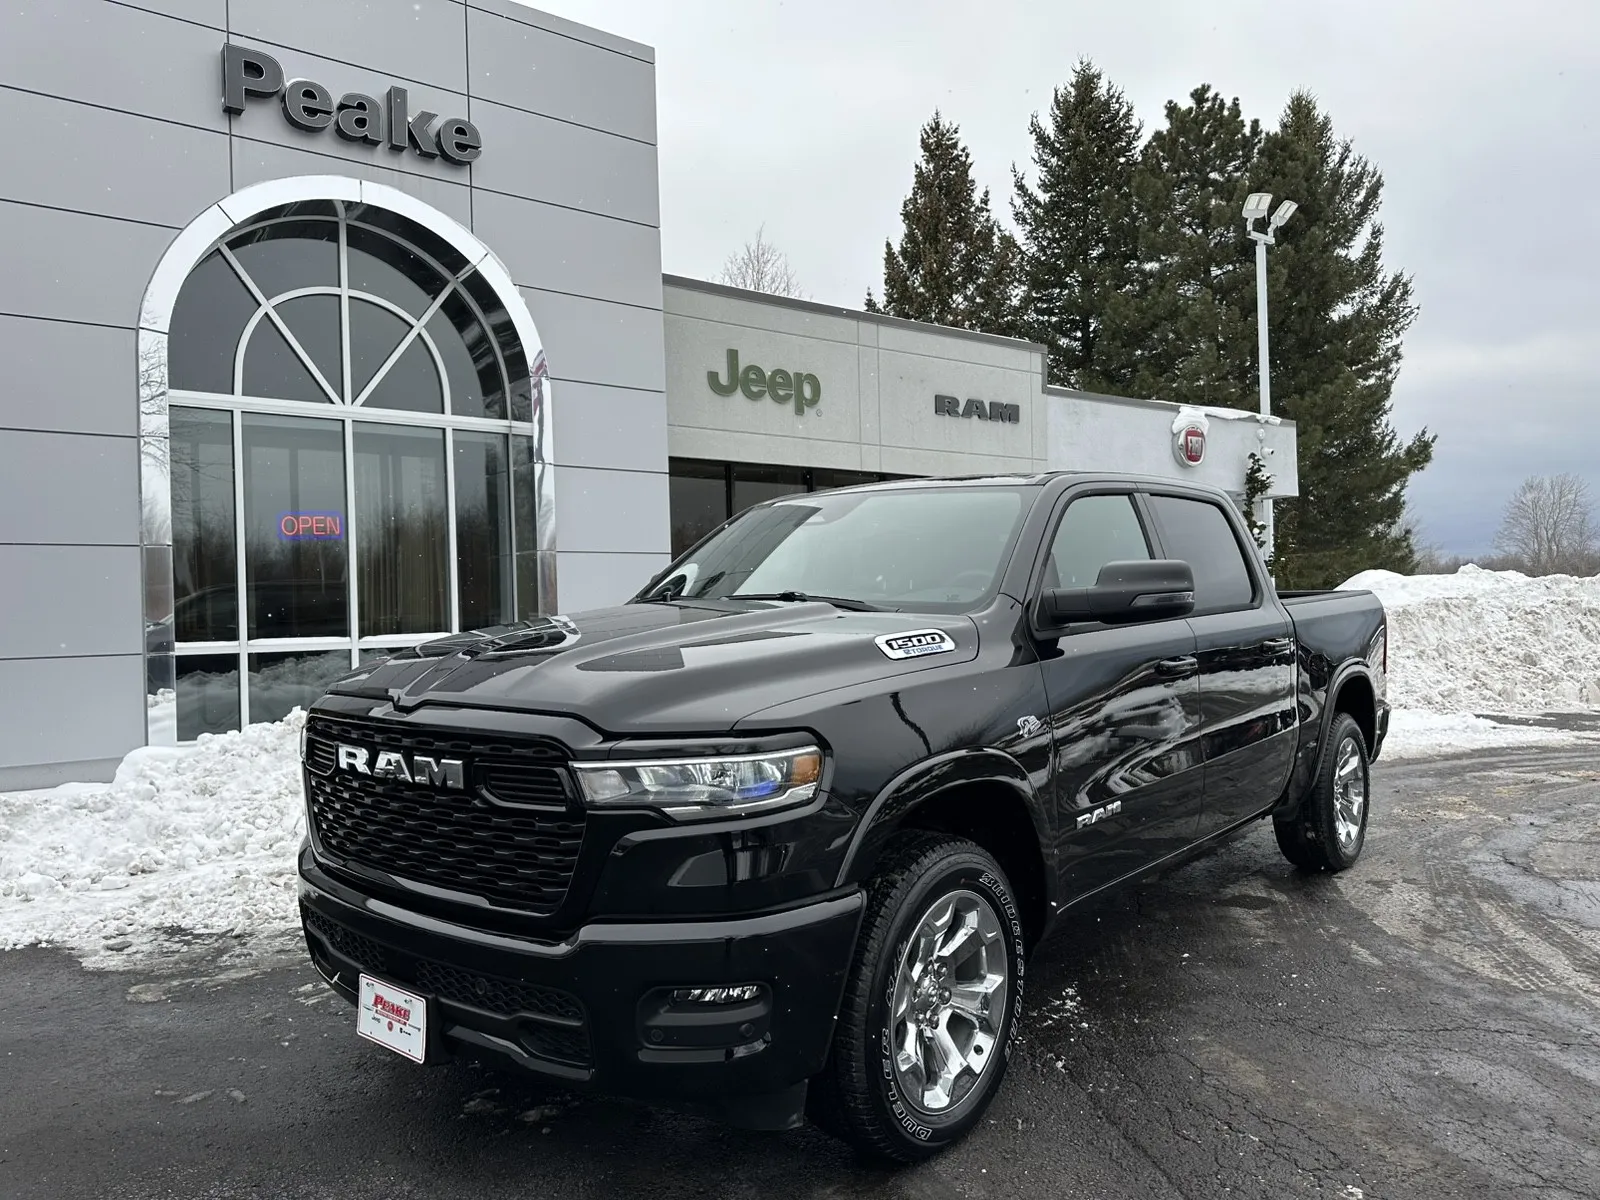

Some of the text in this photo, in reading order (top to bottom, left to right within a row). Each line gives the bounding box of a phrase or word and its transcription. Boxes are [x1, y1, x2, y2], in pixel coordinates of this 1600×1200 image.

[222, 43, 482, 165] Peake
[707, 348, 821, 415] Jeep
[934, 394, 1020, 424] RAM
[281, 515, 340, 535] OPEN
[887, 634, 941, 650] 1500
[338, 743, 464, 789] RAM
[1076, 800, 1122, 829] RAM
[979, 872, 1025, 1062] BRIDGESTONE
